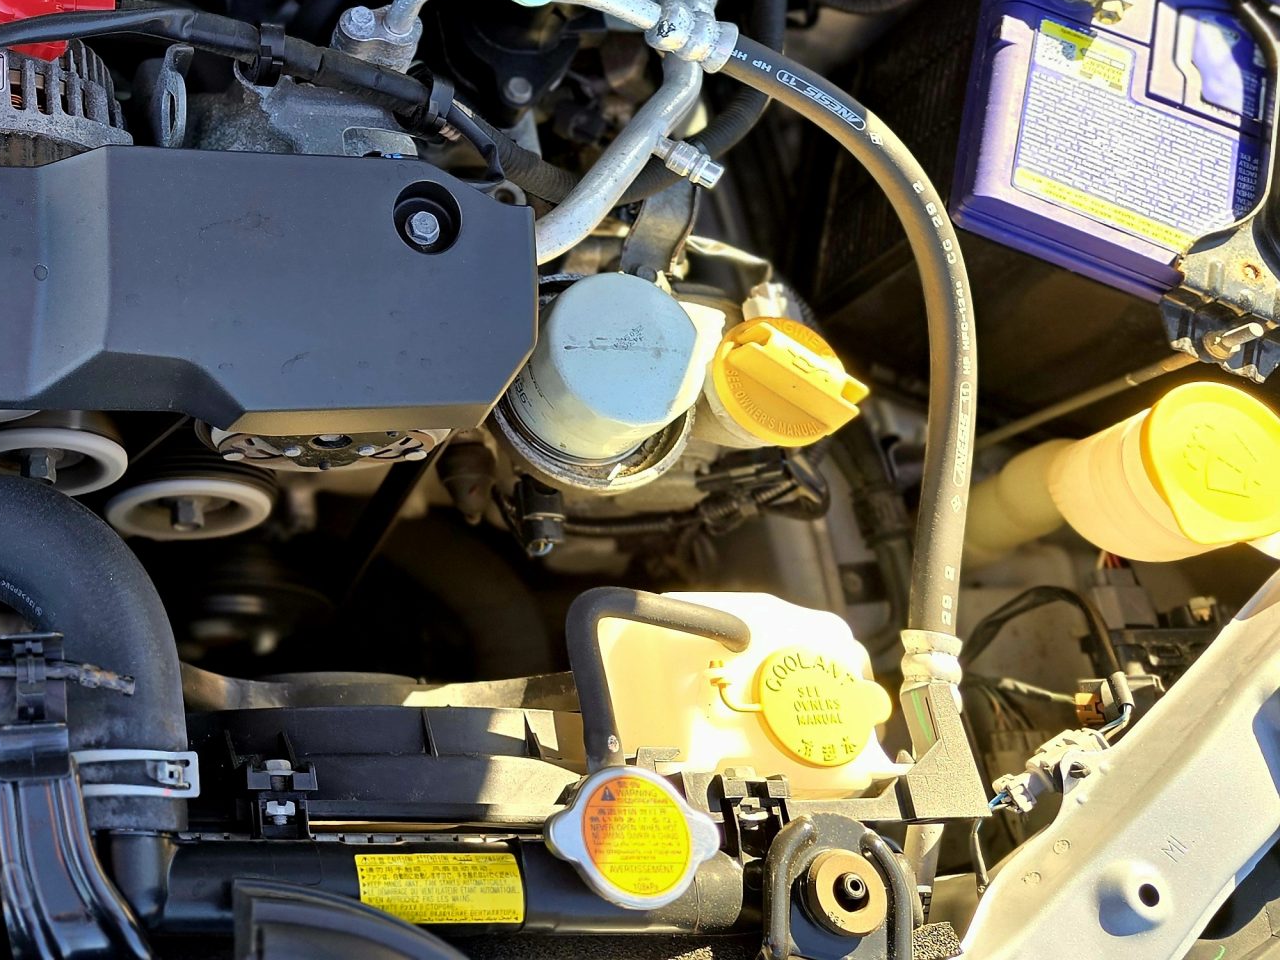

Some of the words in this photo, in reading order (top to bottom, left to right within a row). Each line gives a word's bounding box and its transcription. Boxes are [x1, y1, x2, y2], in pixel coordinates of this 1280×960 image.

[726, 369, 742, 390] SEE
[736, 391, 777, 429] OWNER'S
[778, 422, 821, 438] MANUAL
